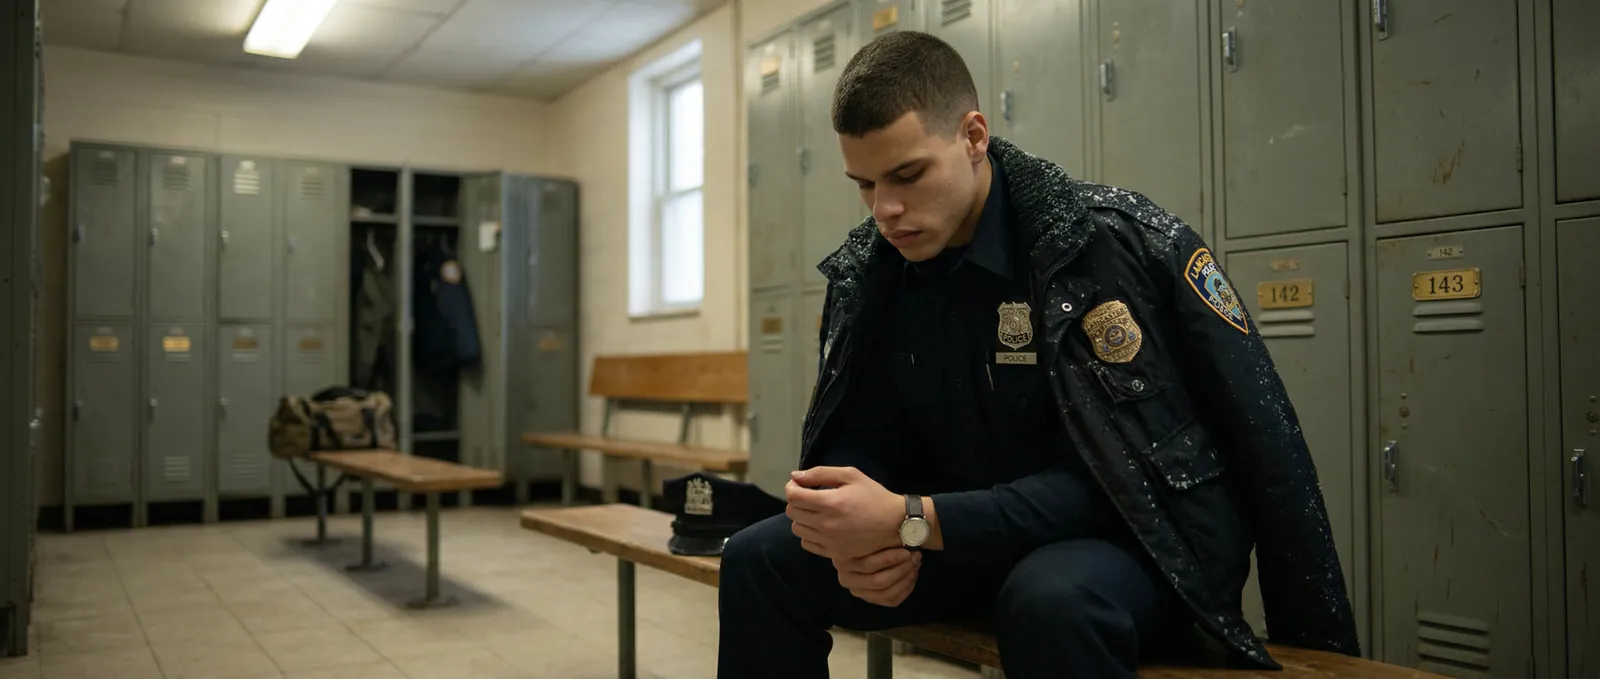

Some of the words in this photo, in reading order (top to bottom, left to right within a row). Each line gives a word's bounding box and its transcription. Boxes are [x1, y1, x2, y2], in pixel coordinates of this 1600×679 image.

[1439, 247, 1454, 257] 142
[1429, 274, 1464, 294] 143
[1271, 284, 1300, 303] 142
[1003, 333, 1028, 343] POLICE
[1003, 354, 1027, 363] POLICE
